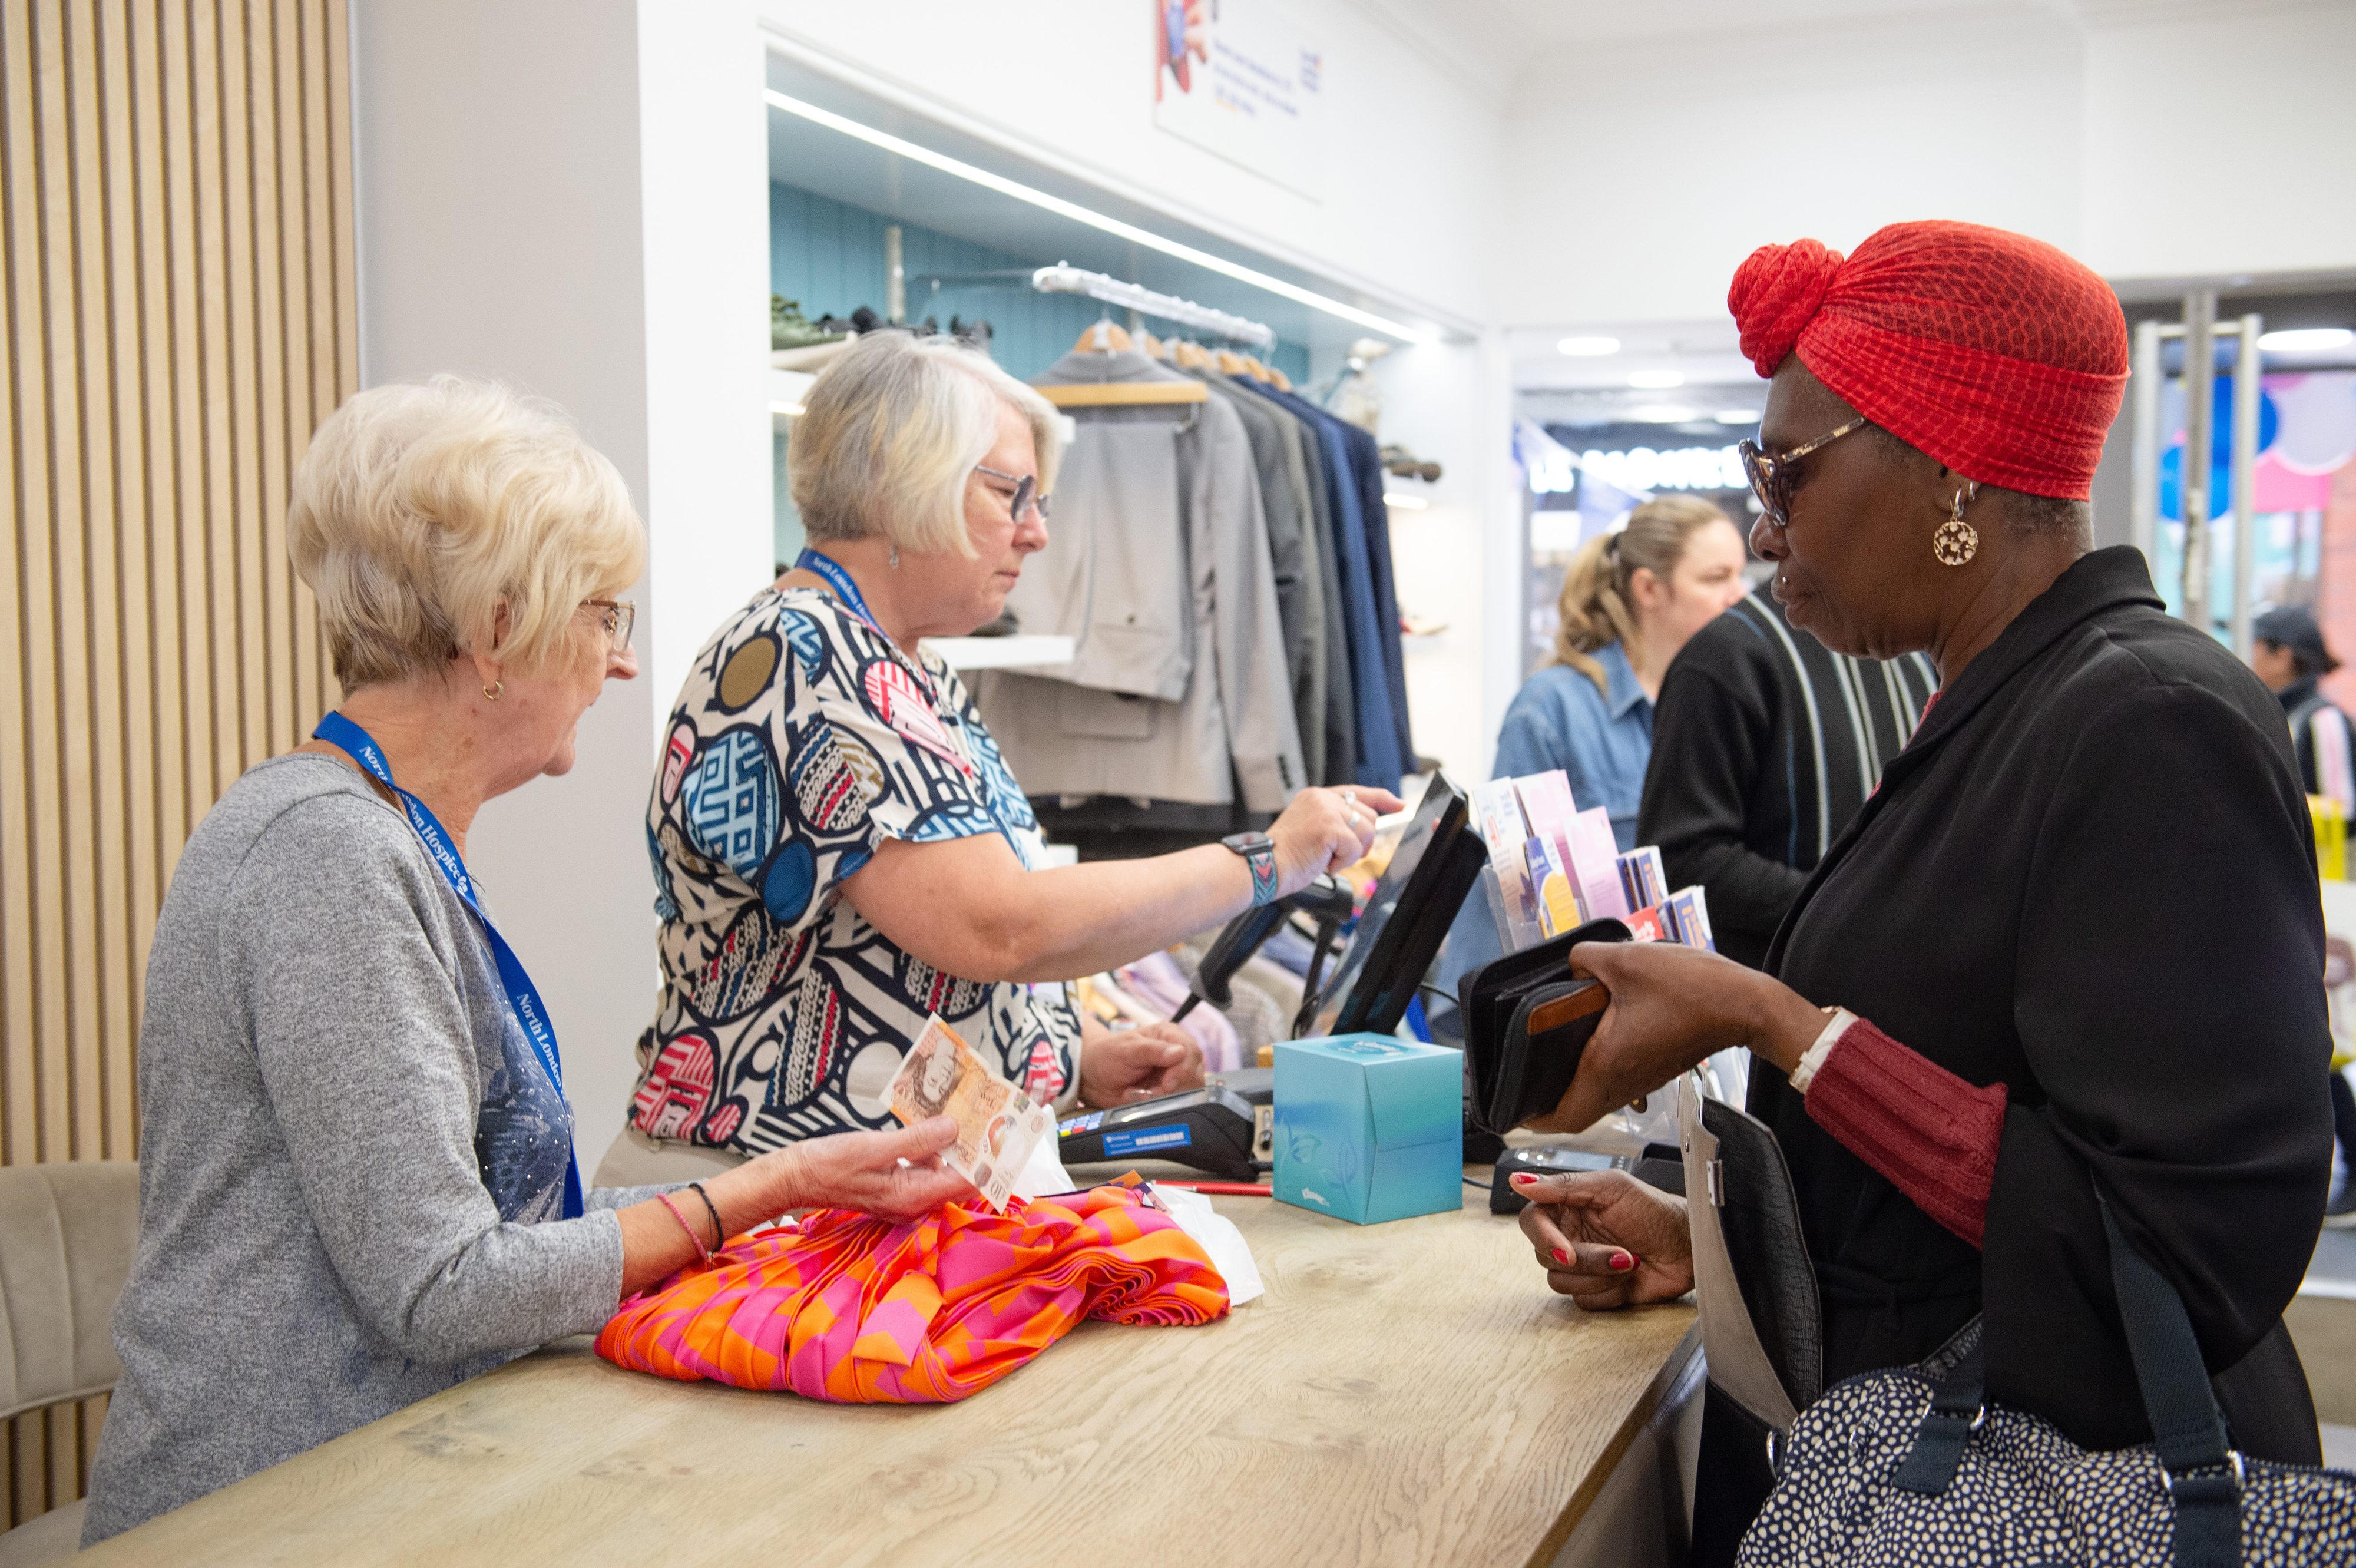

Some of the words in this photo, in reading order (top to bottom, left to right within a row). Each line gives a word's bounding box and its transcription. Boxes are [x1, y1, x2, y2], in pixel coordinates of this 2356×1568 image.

[829, 567, 858, 606] London
[422, 825, 461, 878] Hospice
[517, 993, 543, 1036] North
[537, 1033, 562, 1089] London
